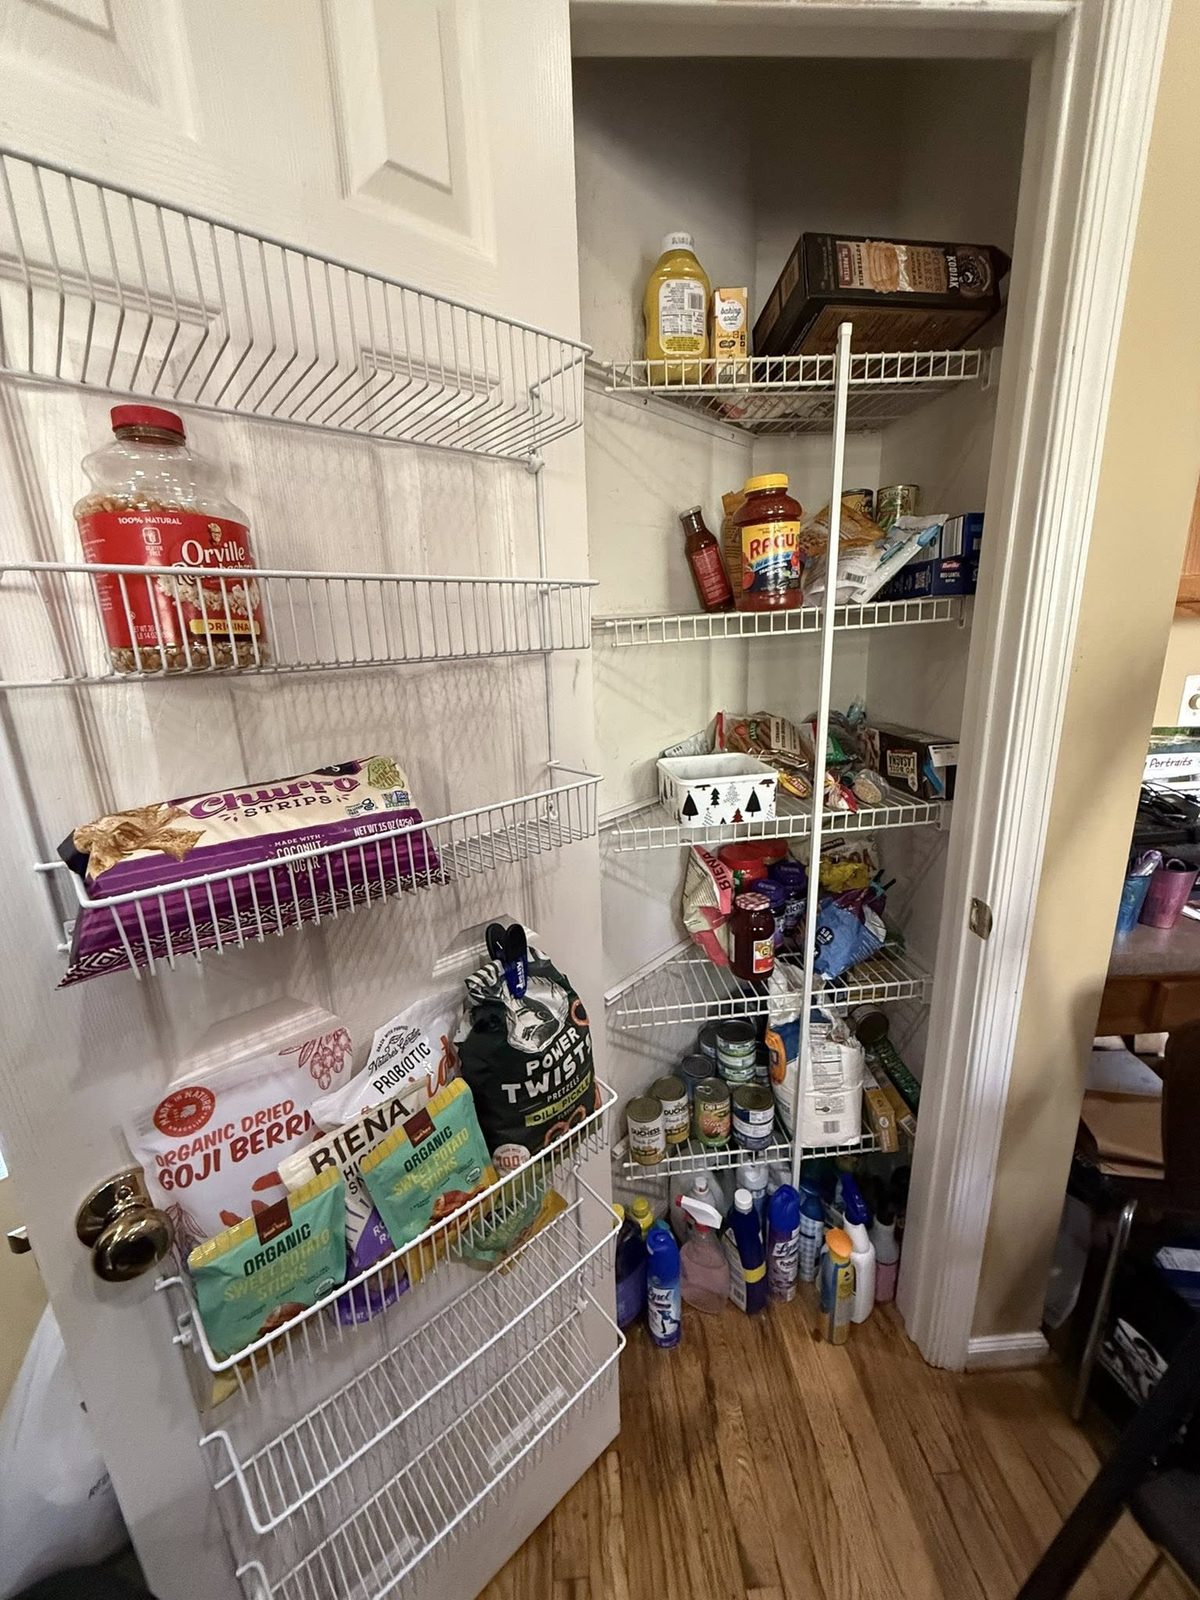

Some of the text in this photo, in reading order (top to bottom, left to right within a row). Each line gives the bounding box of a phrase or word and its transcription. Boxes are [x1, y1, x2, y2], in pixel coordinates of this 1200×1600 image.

[946, 255, 959, 289] KODIAK
[720, 306, 742, 318] baking
[118, 516, 182, 525] 100% NATURAL
[181, 540, 246, 566] Orville
[1149, 757, 1193, 768] Portraits
[188, 776, 360, 819] Churro
[244, 795, 332, 818] STRIPS
[274, 834, 321, 847] MADE WITH
[353, 825, 367, 837] NET
[366, 824, 378, 835] WT
[378, 823, 387, 832] 15
[387, 821, 395, 830] OZ
[702, 851, 731, 891] BIENA
[372, 1042, 432, 1095] PROBIOTIC
[525, 1026, 581, 1078] POWER
[547, 1075, 580, 1103] PRETZELS
[533, 1106, 558, 1123] DILL
[155, 1123, 235, 1168] ORGANIC
[241, 1099, 295, 1133] DRIED
[158, 1149, 222, 1192] GOJI
[229, 1109, 316, 1163] BERRI
[308, 1098, 411, 1176] BIENA
[403, 1125, 453, 1173] ORGANIC
[393, 1162, 432, 1196] SWEET
[432, 1127, 469, 1167] POTATO
[243, 1223, 311, 1277] ORGANIC
